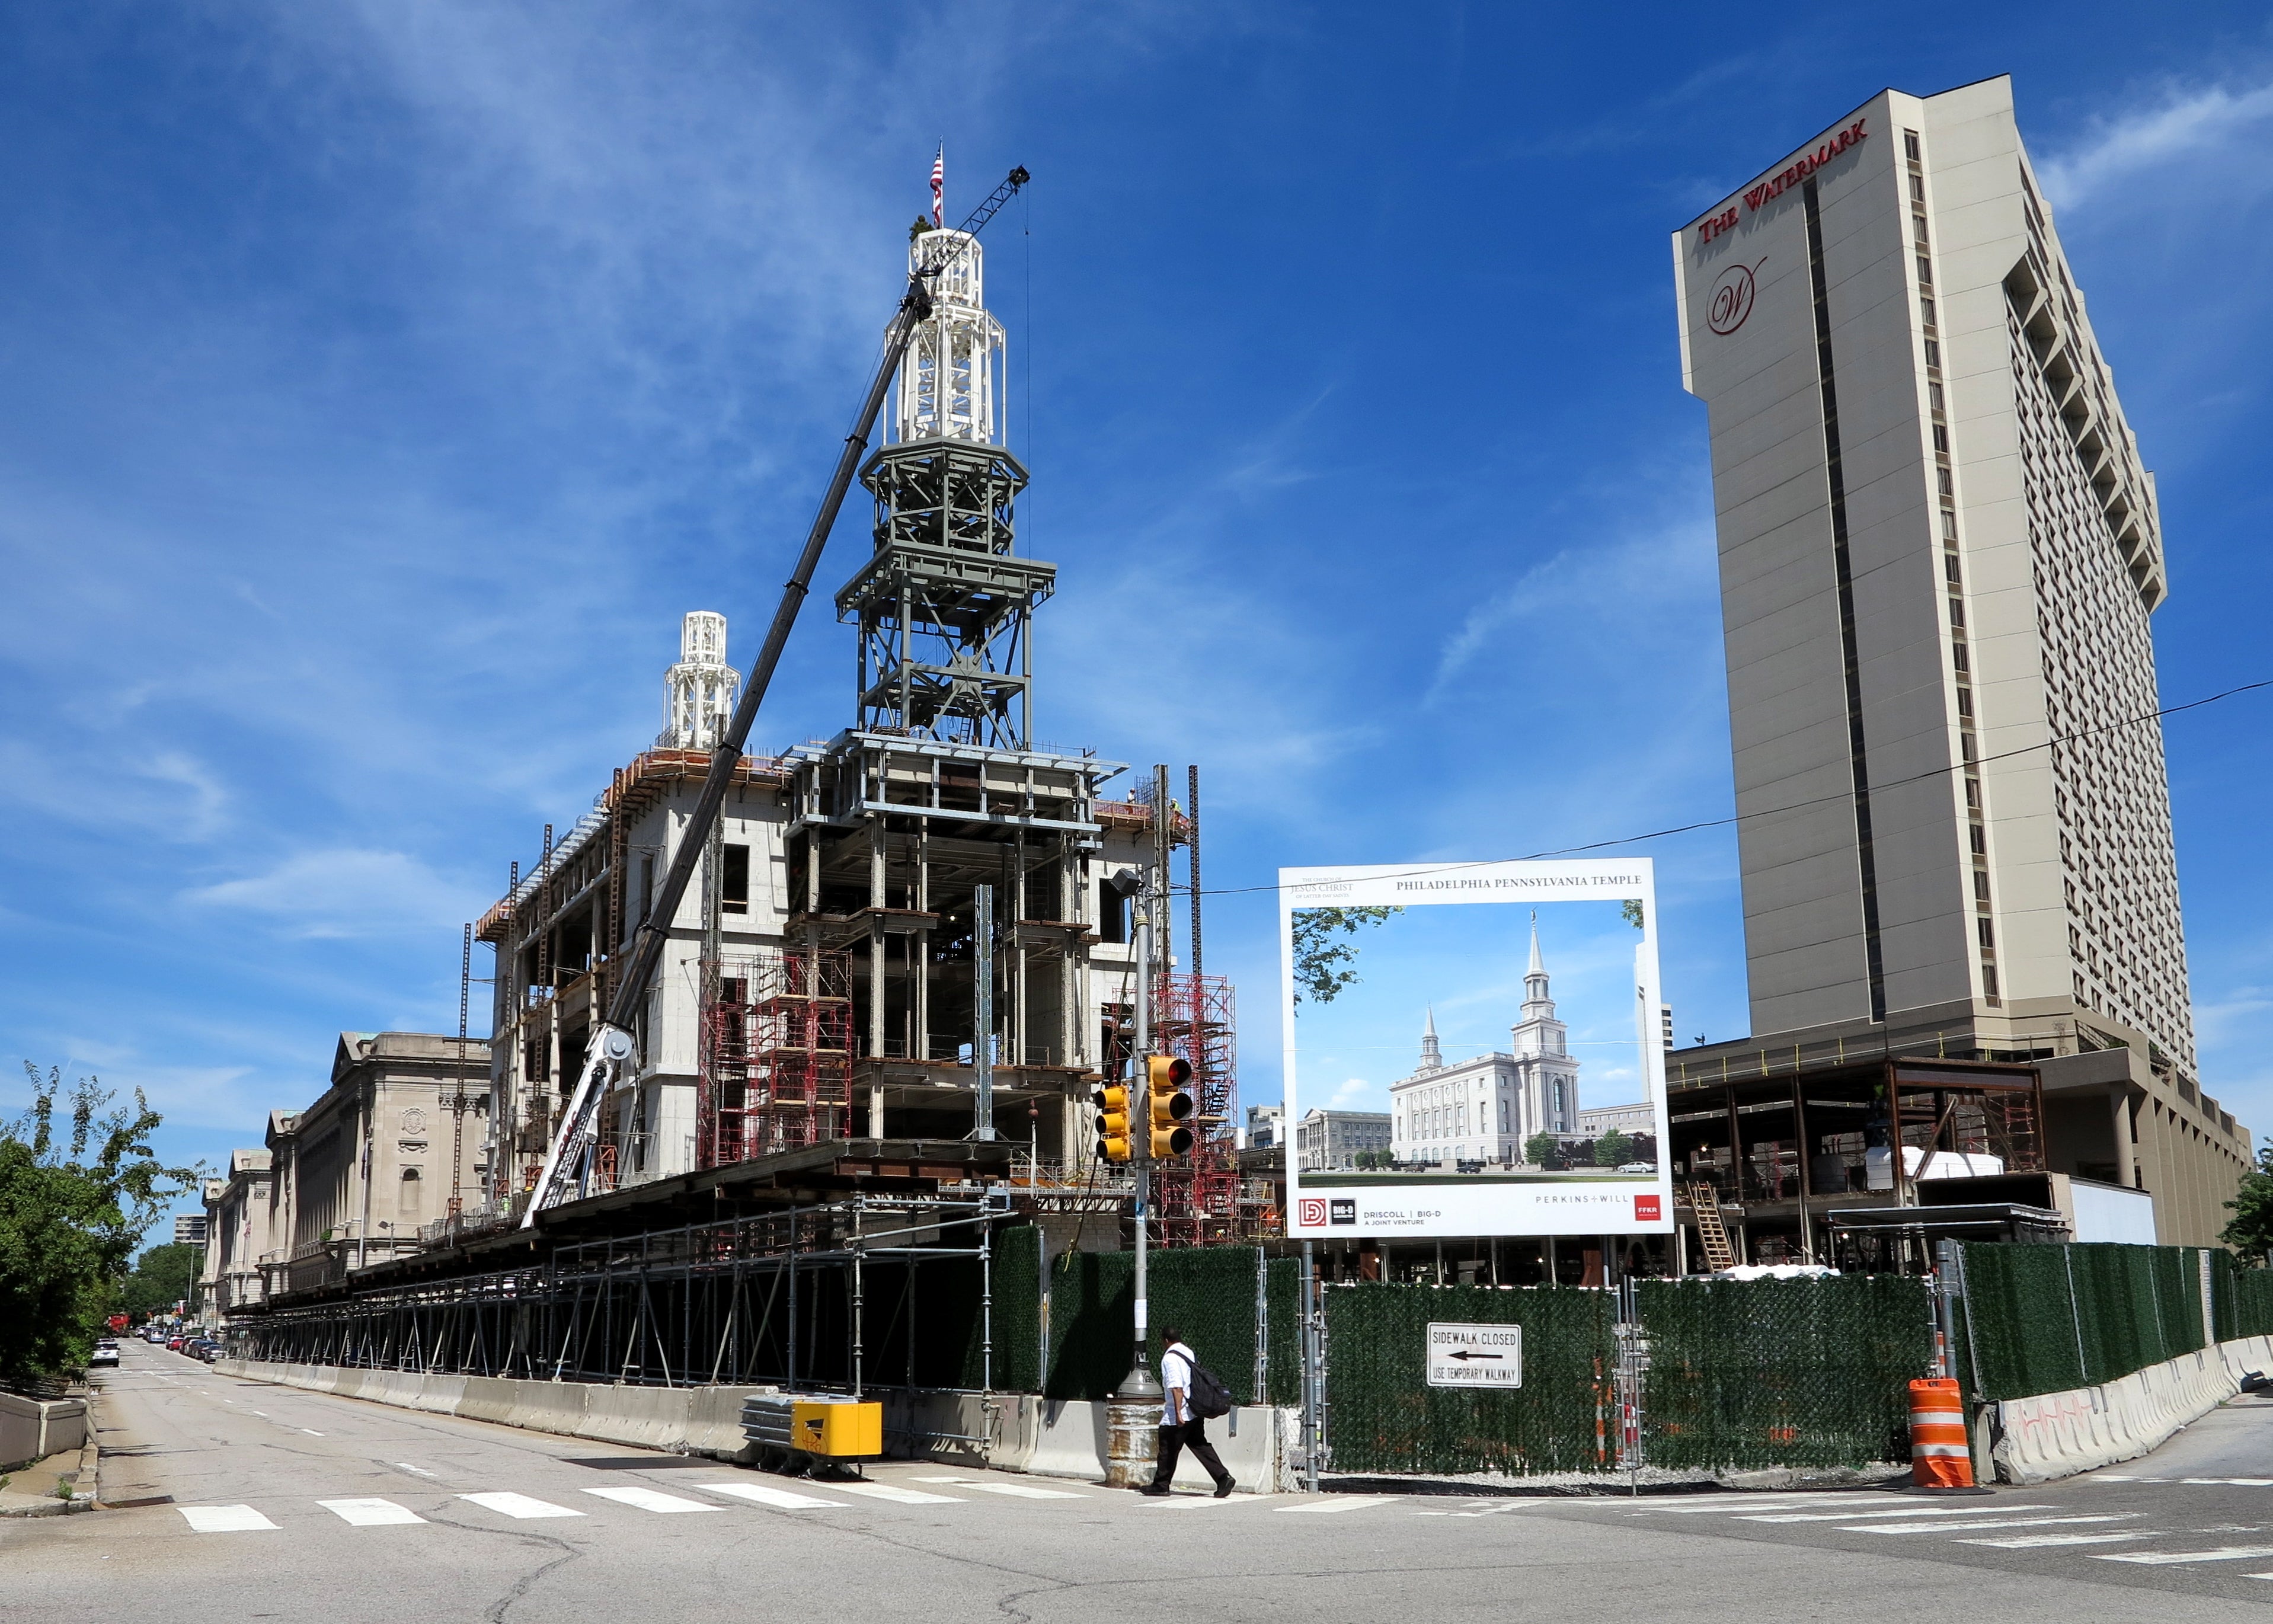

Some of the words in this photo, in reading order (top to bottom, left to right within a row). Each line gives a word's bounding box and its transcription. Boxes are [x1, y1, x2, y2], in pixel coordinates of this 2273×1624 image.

[1290, 884, 1316, 894] JESUS
[1396, 880, 1491, 890] PHILADELPHIA
[1495, 877, 1588, 888] PENNSYLVANIA
[1591, 875, 1642, 885] TEMPLE
[1333, 1206, 1353, 1214] BIG-D
[1433, 1332, 1478, 1344] SIDEWALK
[1482, 1333, 1516, 1345] CLOSED
[1433, 1367, 1445, 1379] USE
[1447, 1368, 1482, 1380] TEMPORARY
[1485, 1369, 1516, 1381] WALKWAY
